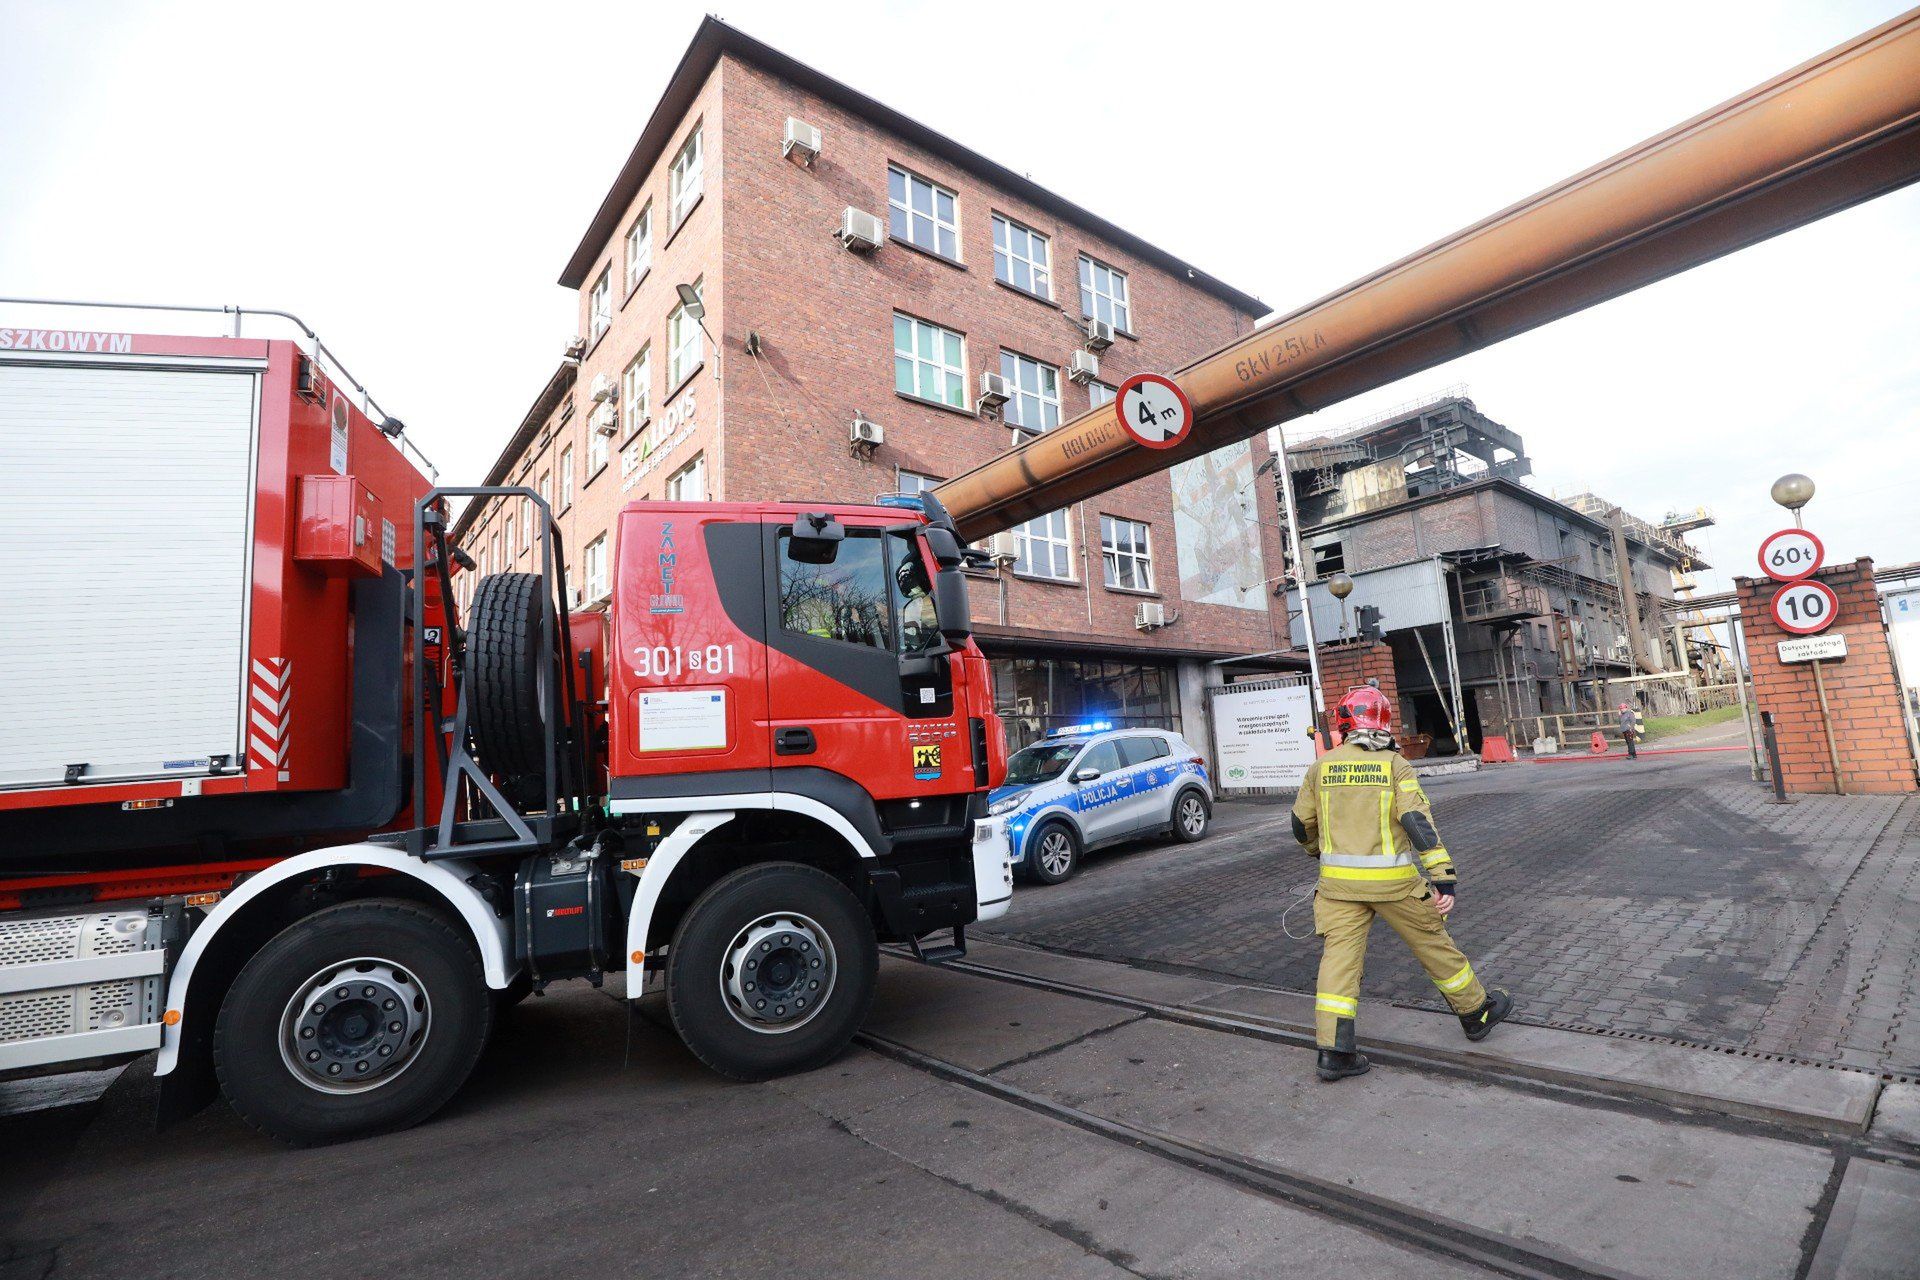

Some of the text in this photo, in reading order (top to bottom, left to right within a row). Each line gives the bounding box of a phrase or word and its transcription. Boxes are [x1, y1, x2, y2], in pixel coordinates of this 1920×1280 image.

[1236, 350, 1271, 381] 6kV
[1139, 401, 1176, 426] 4 m
[659, 522, 676, 594] ZAMET
[1785, 593, 1824, 621] 10
[634, 645, 681, 677] 301
[706, 644, 734, 674] 81
[1081, 784, 1119, 806] POLICJA
